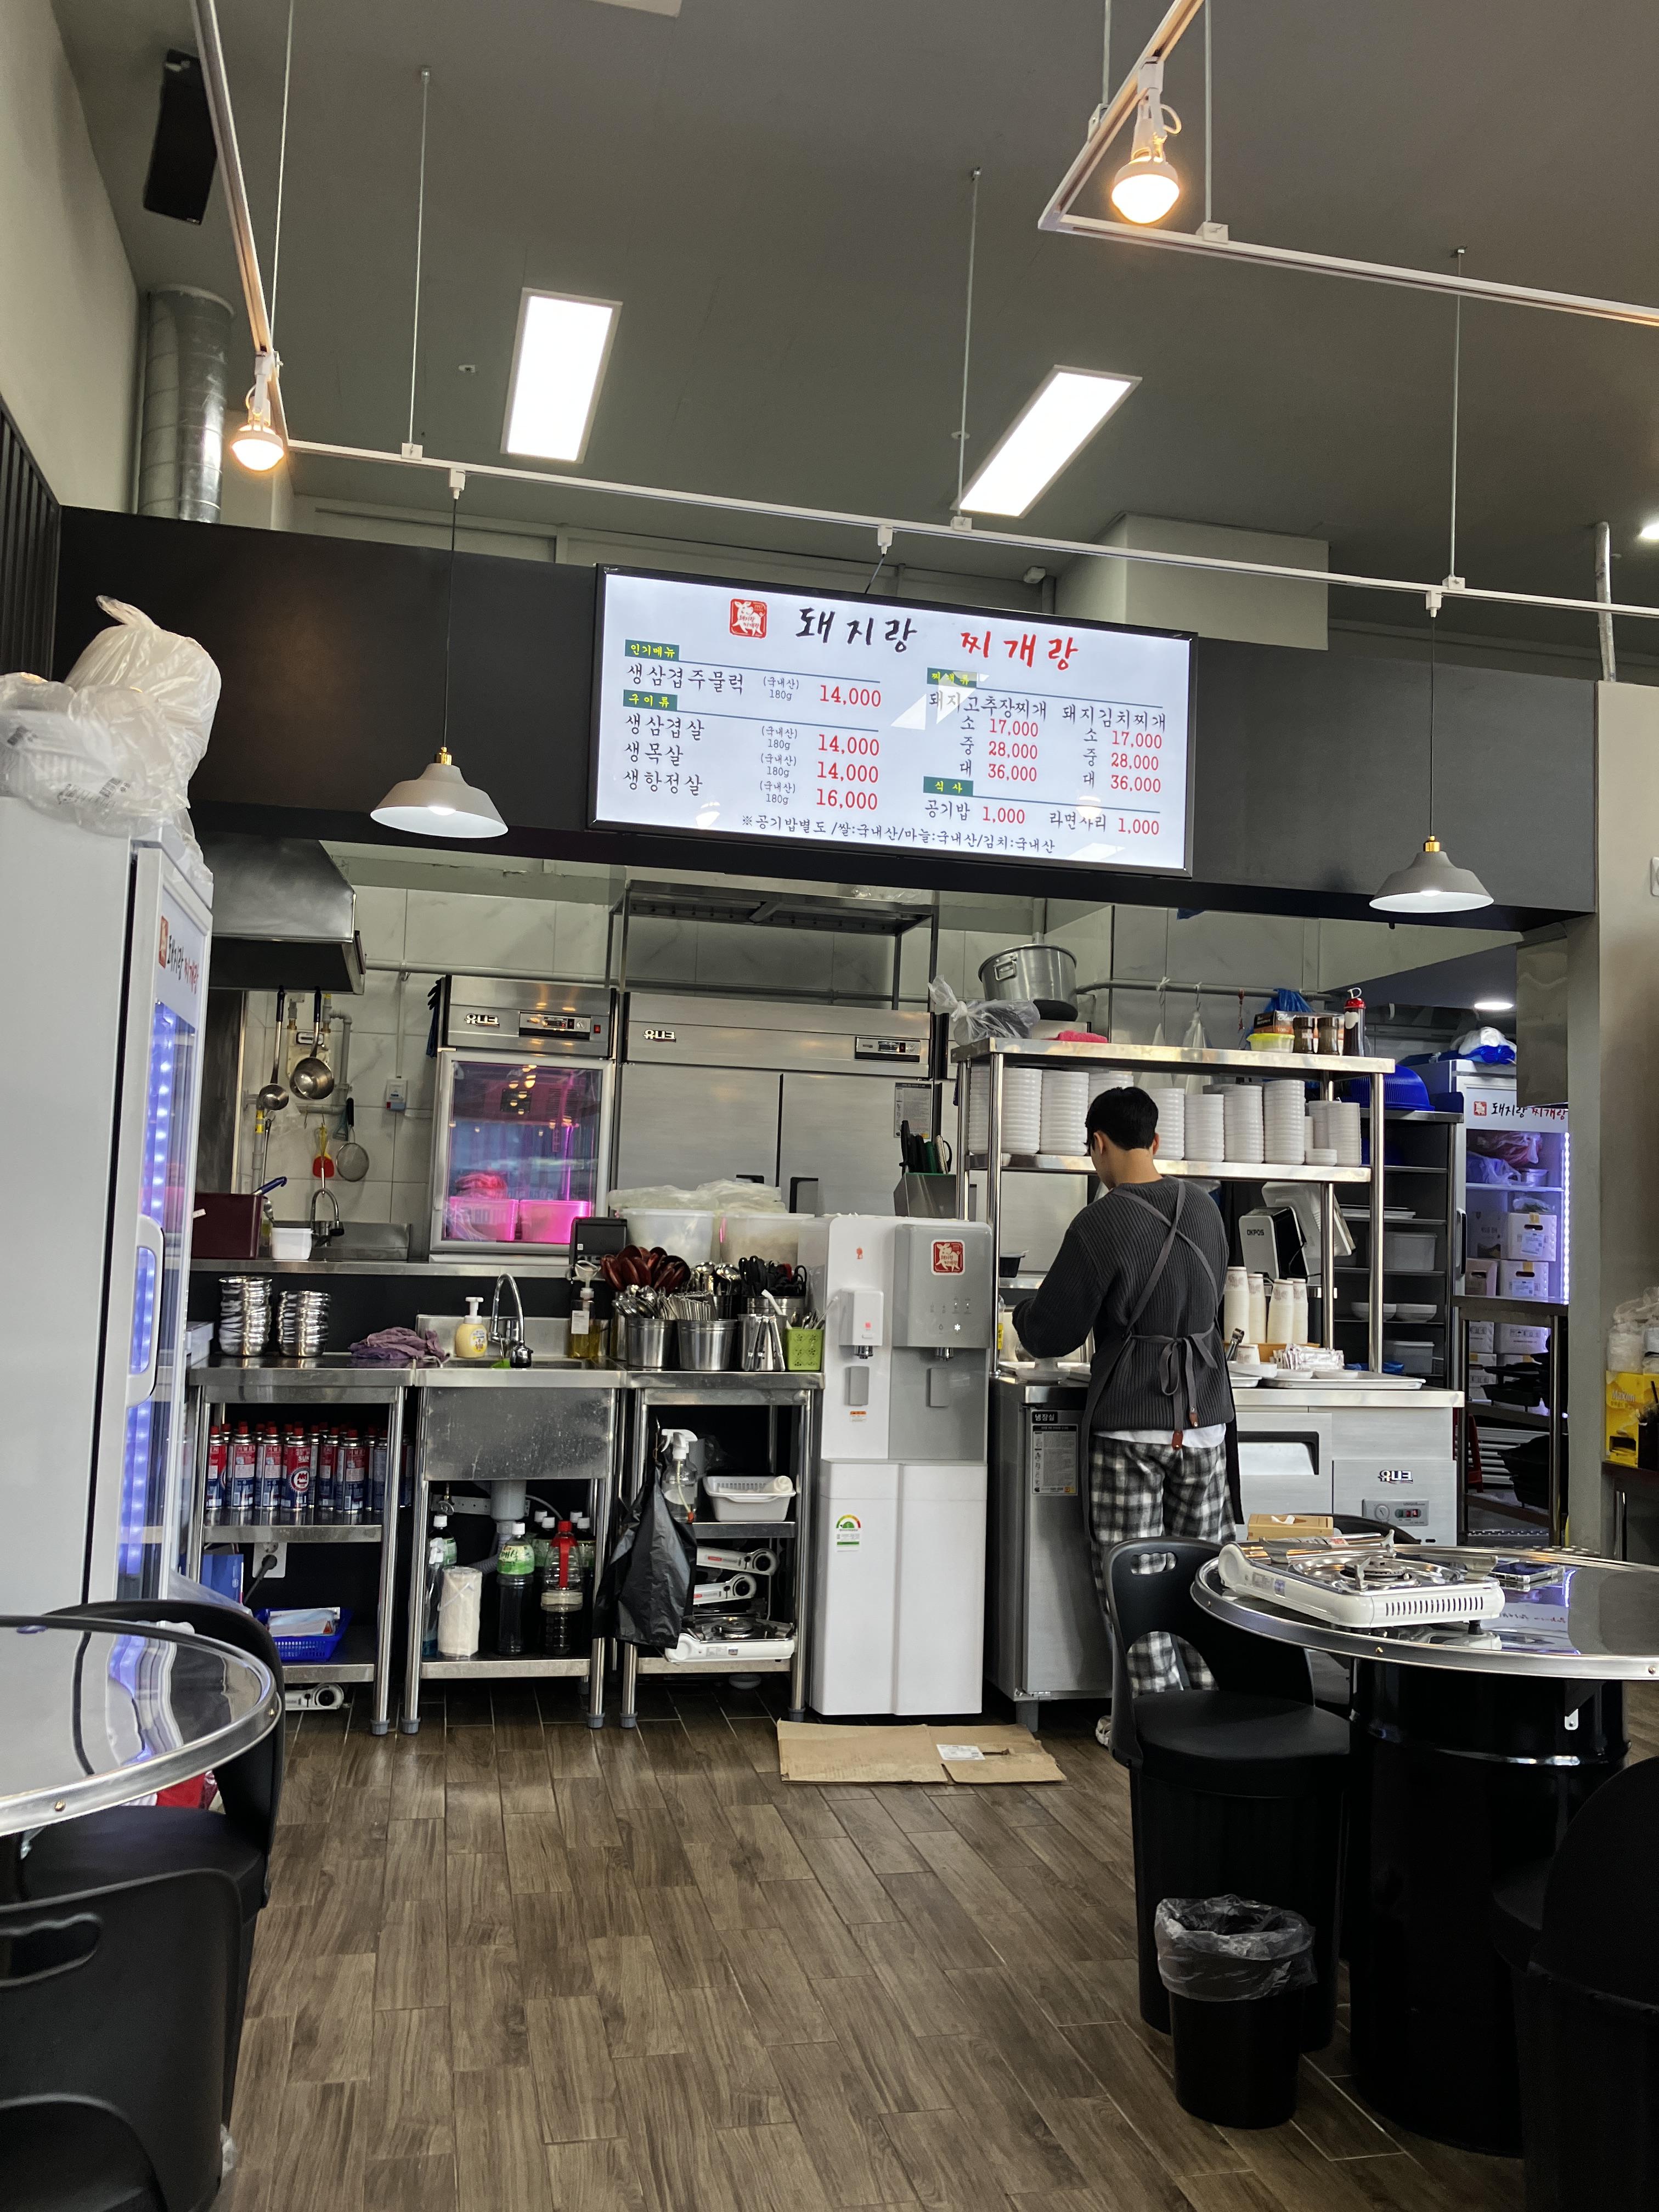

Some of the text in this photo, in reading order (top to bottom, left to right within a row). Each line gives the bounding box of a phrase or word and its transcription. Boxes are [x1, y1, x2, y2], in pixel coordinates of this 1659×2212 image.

[630, 644, 676, 658] 인기메뉴
[795, 606, 1079, 672] 돼지랑 찌개랑
[627, 662, 882, 708] 생삼겹주물럭 (국내산) 180g 14,000
[628, 693, 670, 708] 구이류
[929, 691, 1046, 721] 돼지고추장찌개
[961, 715, 1039, 738] 소 17,000
[1062, 704, 1165, 731] 돼지김치찌개
[625, 713, 881, 757] 생삼겹살 (국내산) 180g 14,000
[1084, 727, 1163, 750] 소 17,000
[960, 736, 1039, 760] 중 28,000
[1083, 748, 1159, 772] 중 28,000
[625, 741, 879, 784] 생목살 (국내산) 180g 14,000
[960, 759, 1037, 782] 대 36,000
[623, 768, 878, 811] 생항정살 (국내산) 180g 16,000
[935, 781, 963, 794] 식사
[1083, 770, 1161, 794] 대 36,000
[925, 800, 1026, 825] 공기밥 1,000
[1049, 811, 1159, 836] 라면사리 1,000
[1491, 1103, 1528, 1118] 돼지랑
[1612, 1390, 1635, 1403] Maxim
